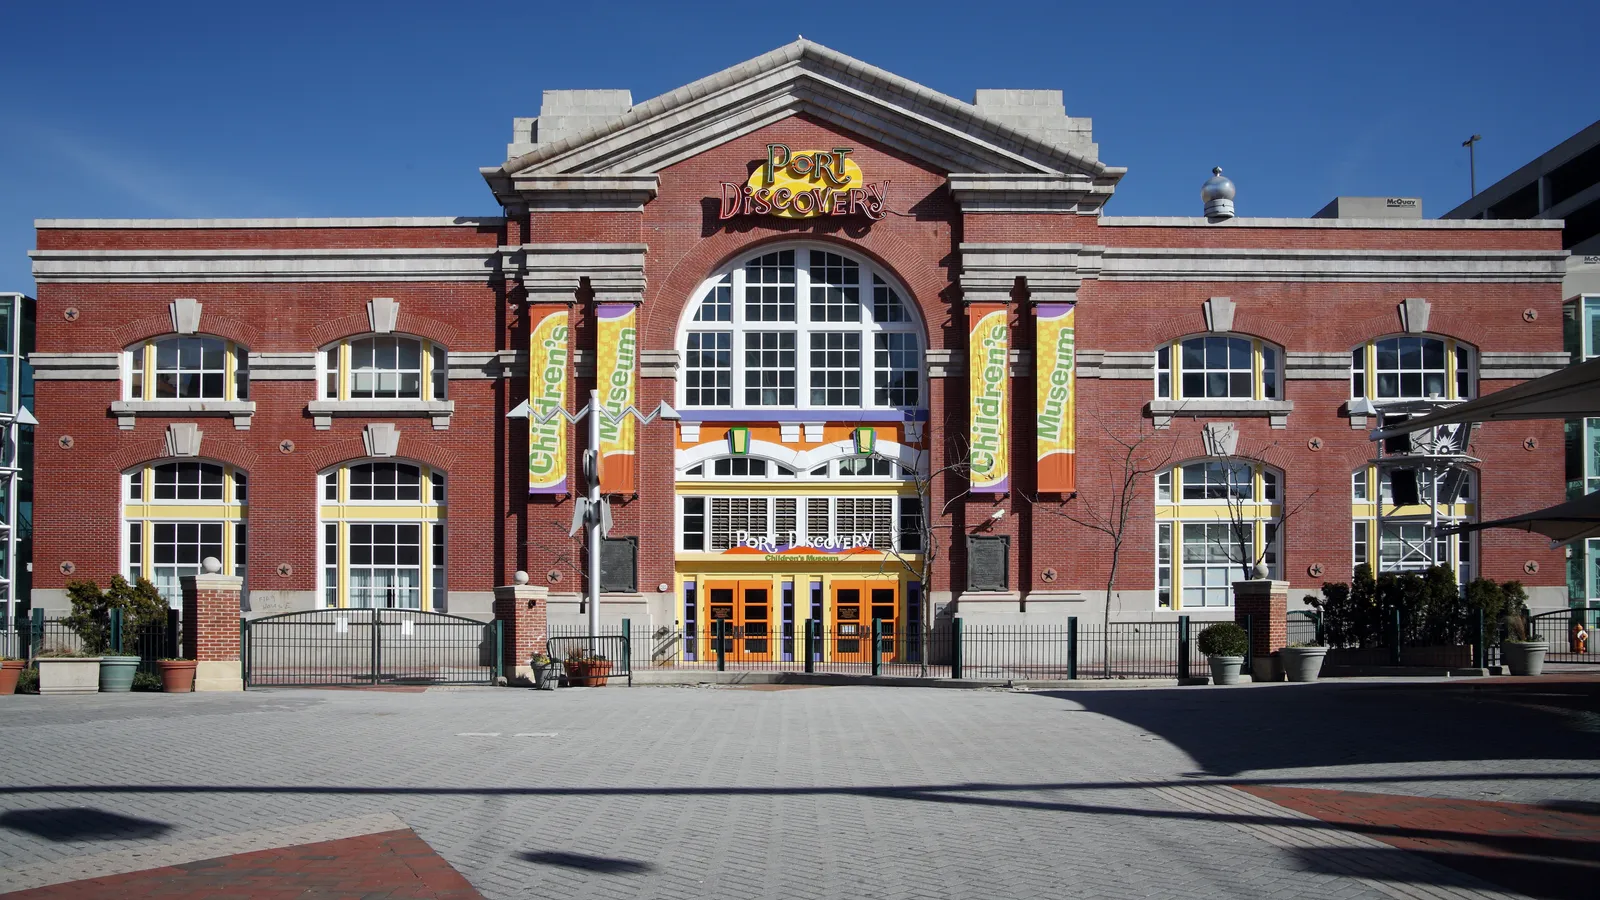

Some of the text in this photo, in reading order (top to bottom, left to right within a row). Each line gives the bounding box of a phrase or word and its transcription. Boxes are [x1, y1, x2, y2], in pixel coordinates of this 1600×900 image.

[766, 143, 854, 184] PORT
[529, 326, 568, 473] Children's
[600, 328, 636, 440] Museum
[971, 326, 1007, 473] Children's
[1037, 328, 1075, 440] Museum
